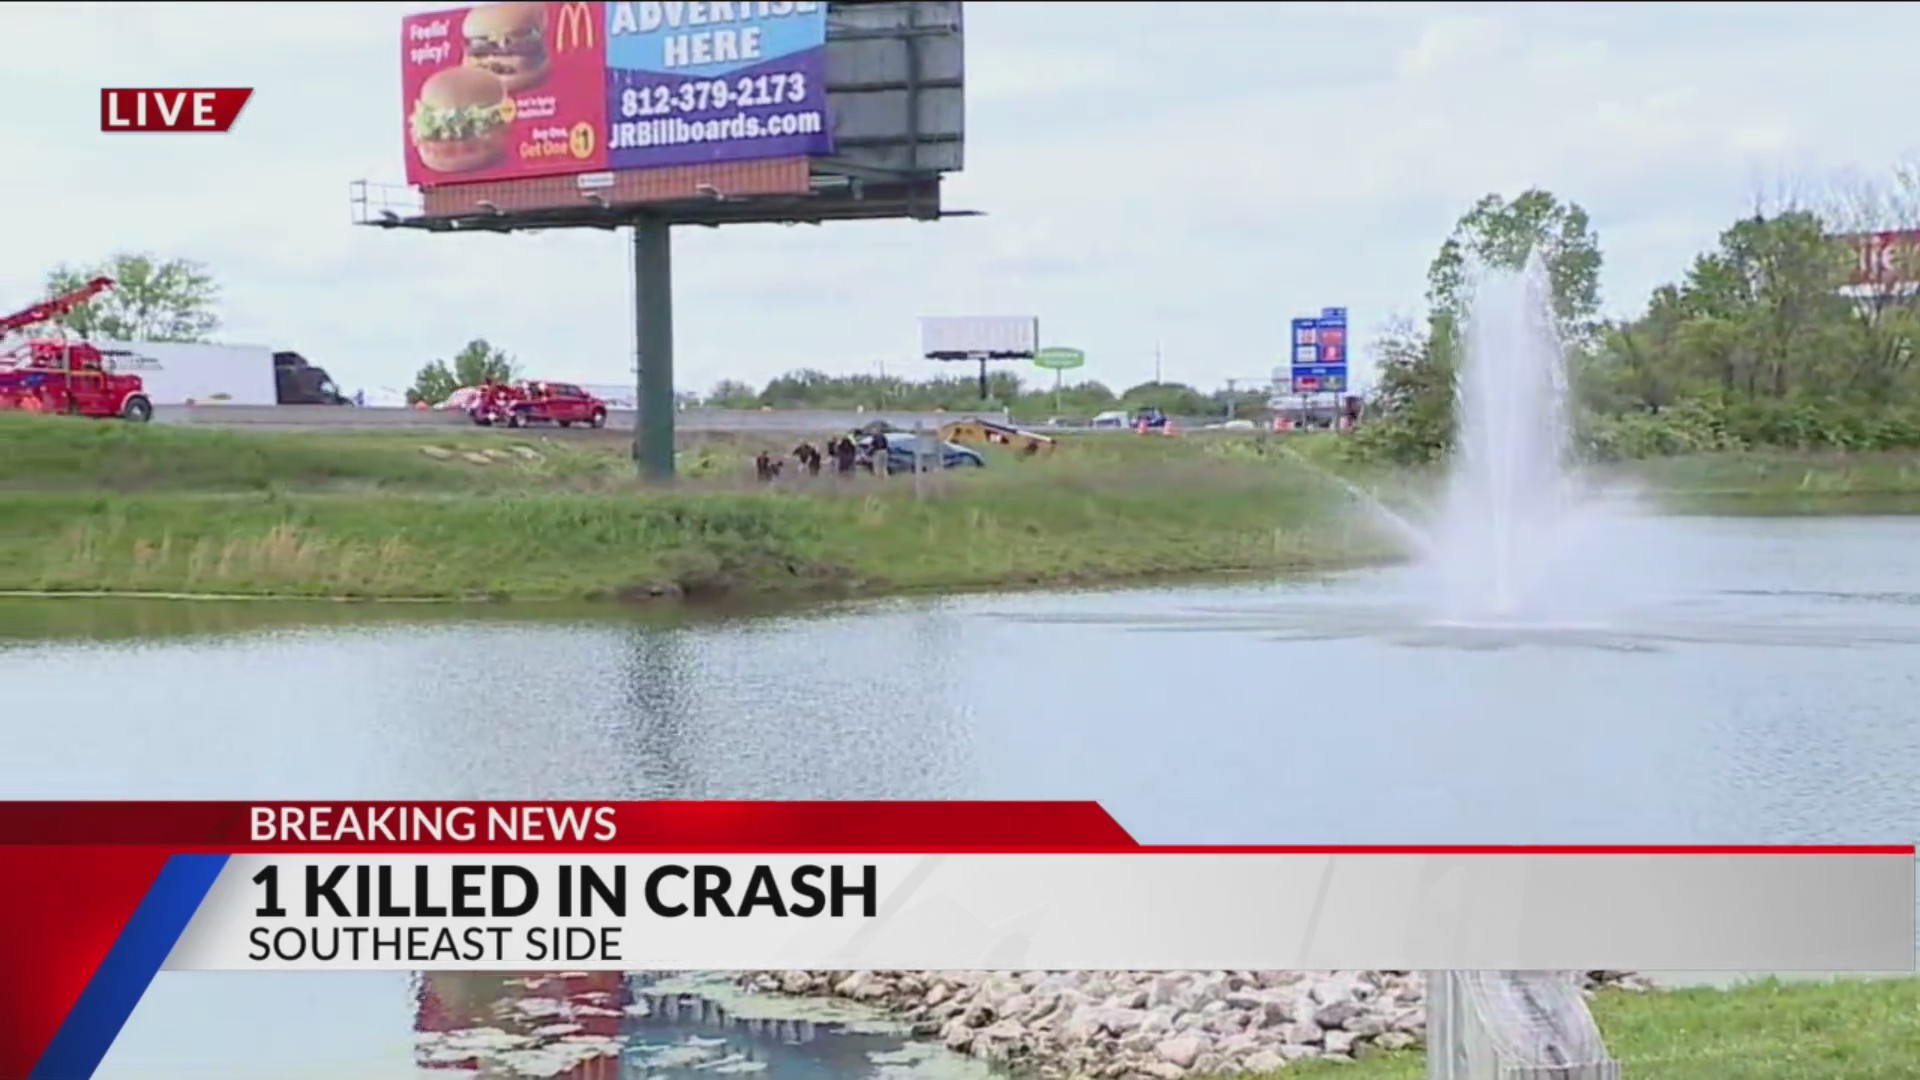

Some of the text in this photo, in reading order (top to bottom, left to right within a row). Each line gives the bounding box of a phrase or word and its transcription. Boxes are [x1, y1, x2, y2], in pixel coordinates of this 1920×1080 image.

[410, 42, 451, 66] spicy?
[664, 27, 761, 67] HERE
[621, 73, 807, 118] 812-379-2173
[608, 111, 821, 150] JRBillboards.com
